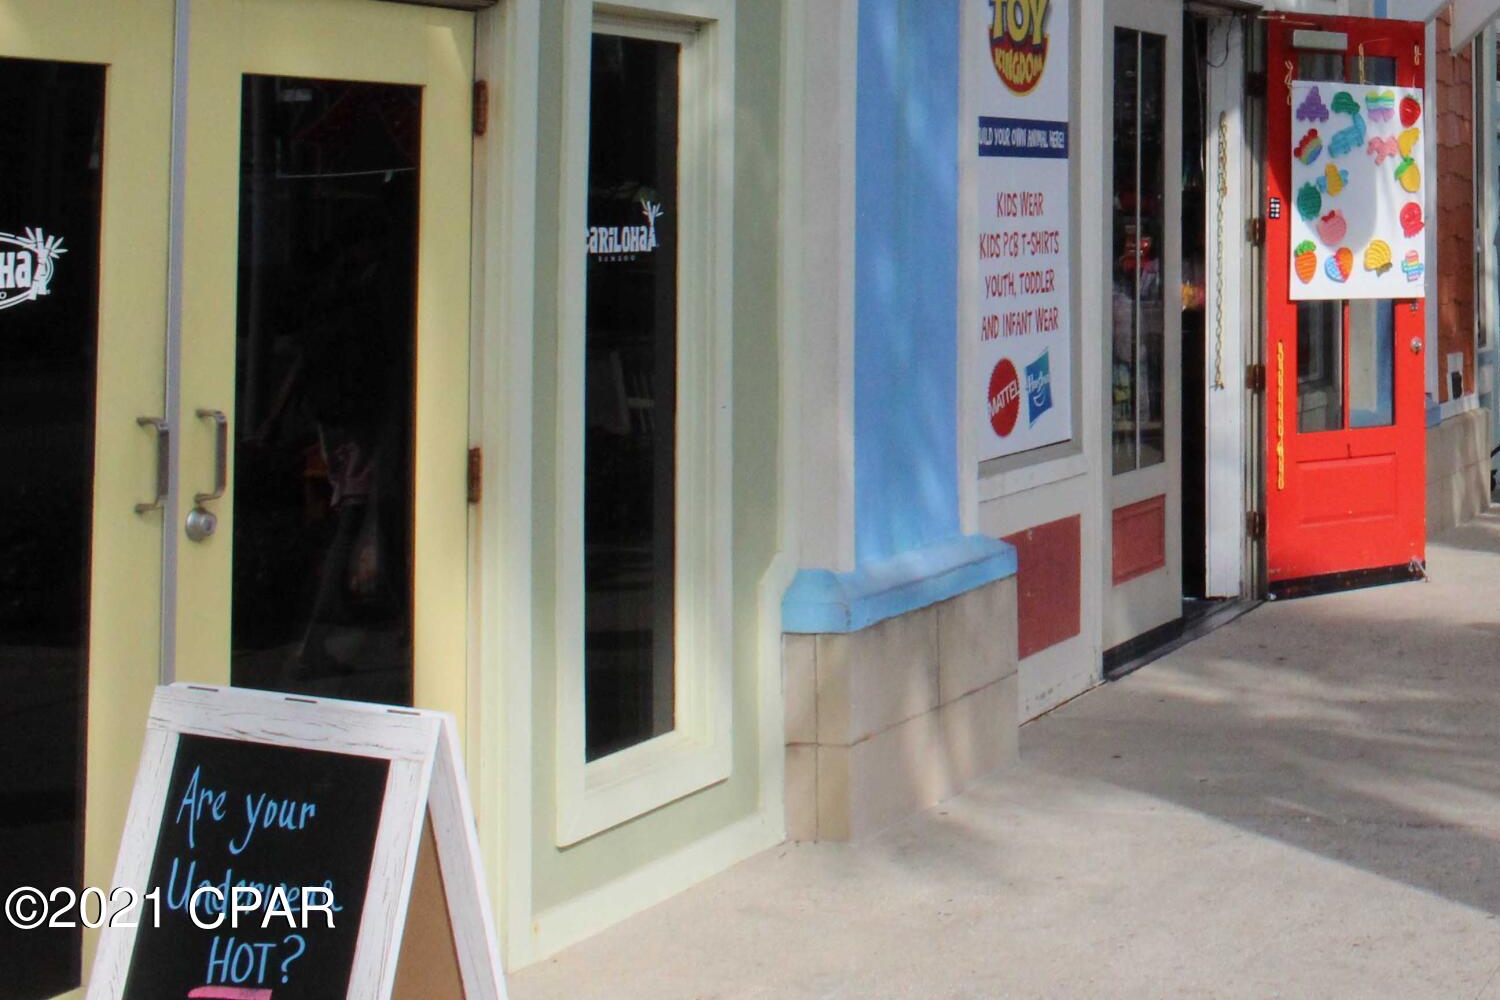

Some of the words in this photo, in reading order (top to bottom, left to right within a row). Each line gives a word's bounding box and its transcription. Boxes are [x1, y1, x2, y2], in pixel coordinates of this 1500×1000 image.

[994, 47, 1045, 86] KINGDOM
[994, 128, 1011, 147] YOUR
[1011, 128, 1027, 148] OWN
[996, 191, 1018, 218] KIDS
[1020, 190, 1044, 217] WEAR
[979, 231, 1001, 260] KIDS
[1003, 231, 1019, 258] PCB
[1021, 230, 1060, 257] T-SHIRTS
[985, 271, 1017, 299] YOUTH,
[1019, 269, 1055, 295] TODDLER
[981, 313, 1000, 341] AND
[1002, 309, 1033, 338] INFANT
[1034, 307, 1059, 333] WEAR
[989, 379, 1020, 417] MATTEL
[176, 765, 228, 849] Are
[229, 793, 317, 855] your
[206, 934, 307, 985] HOT?
